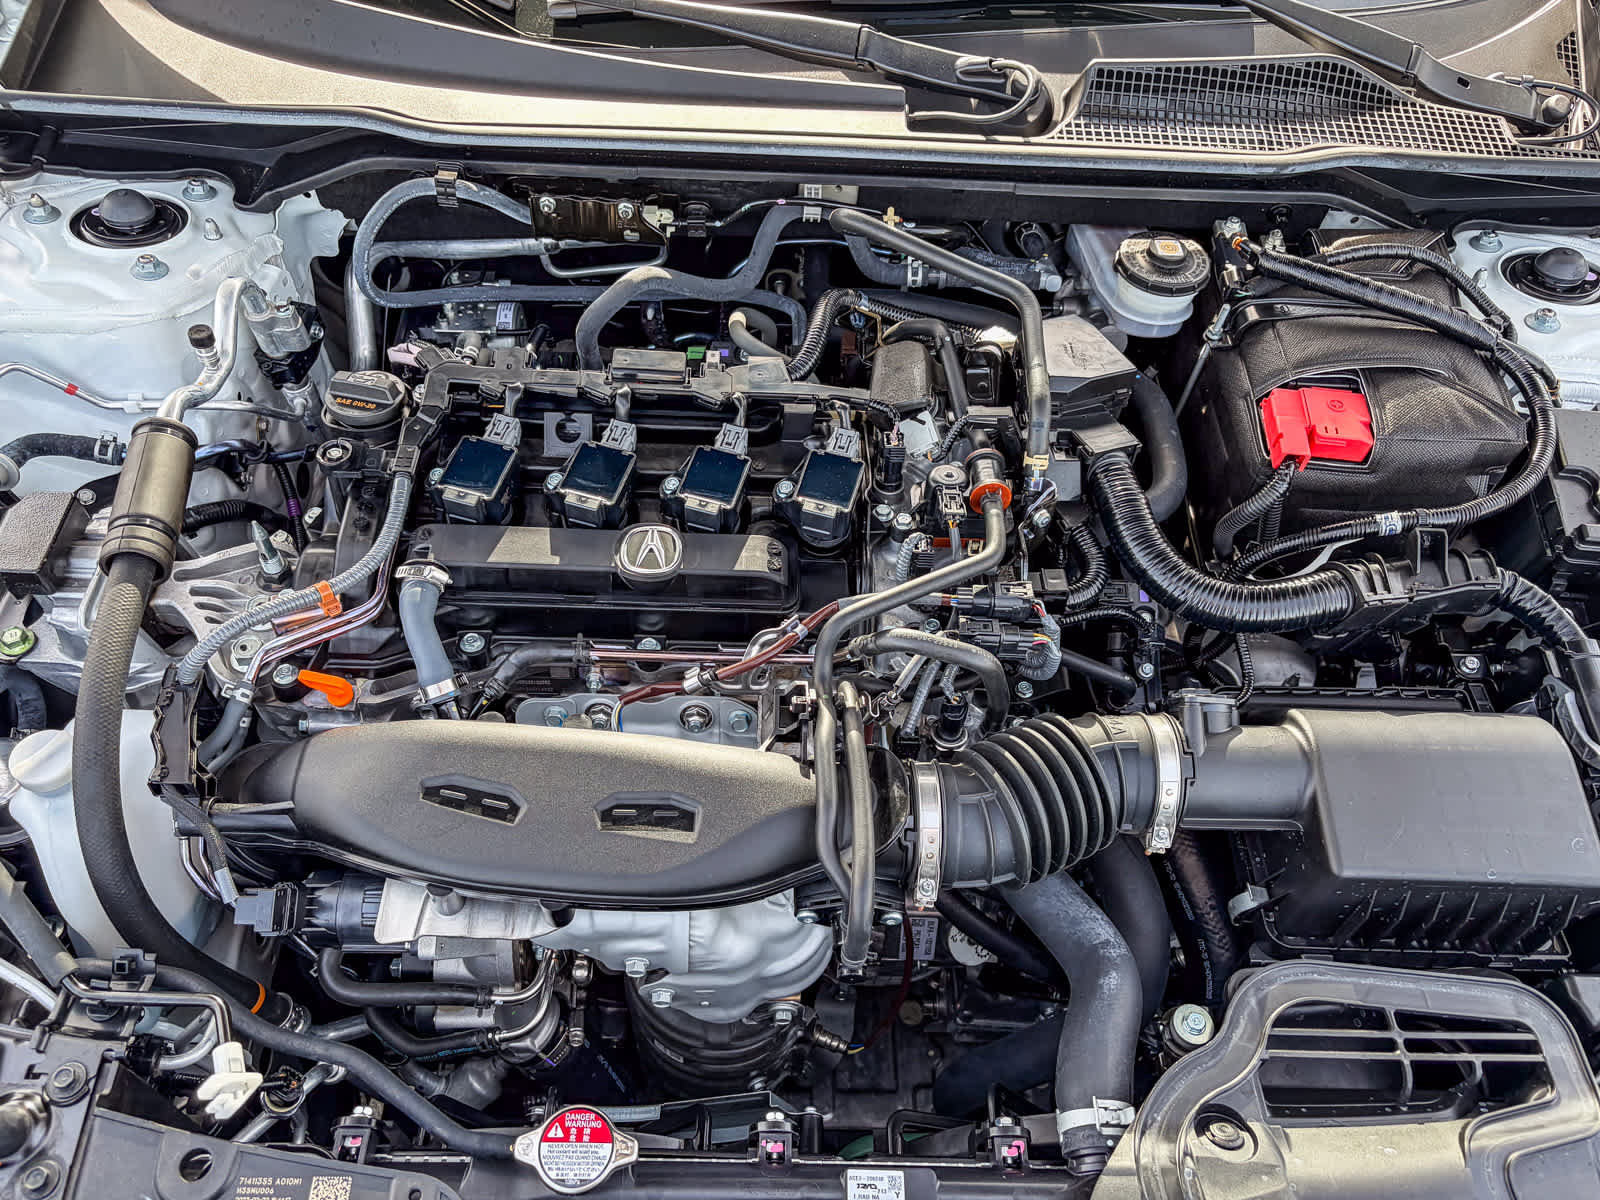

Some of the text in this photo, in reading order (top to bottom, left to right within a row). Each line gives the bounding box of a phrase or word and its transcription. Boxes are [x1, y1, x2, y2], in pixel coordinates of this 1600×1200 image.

[336, 397, 352, 405] SAE
[565, 1113, 596, 1121] DANGER
[565, 1120, 602, 1128] WARNUNG
